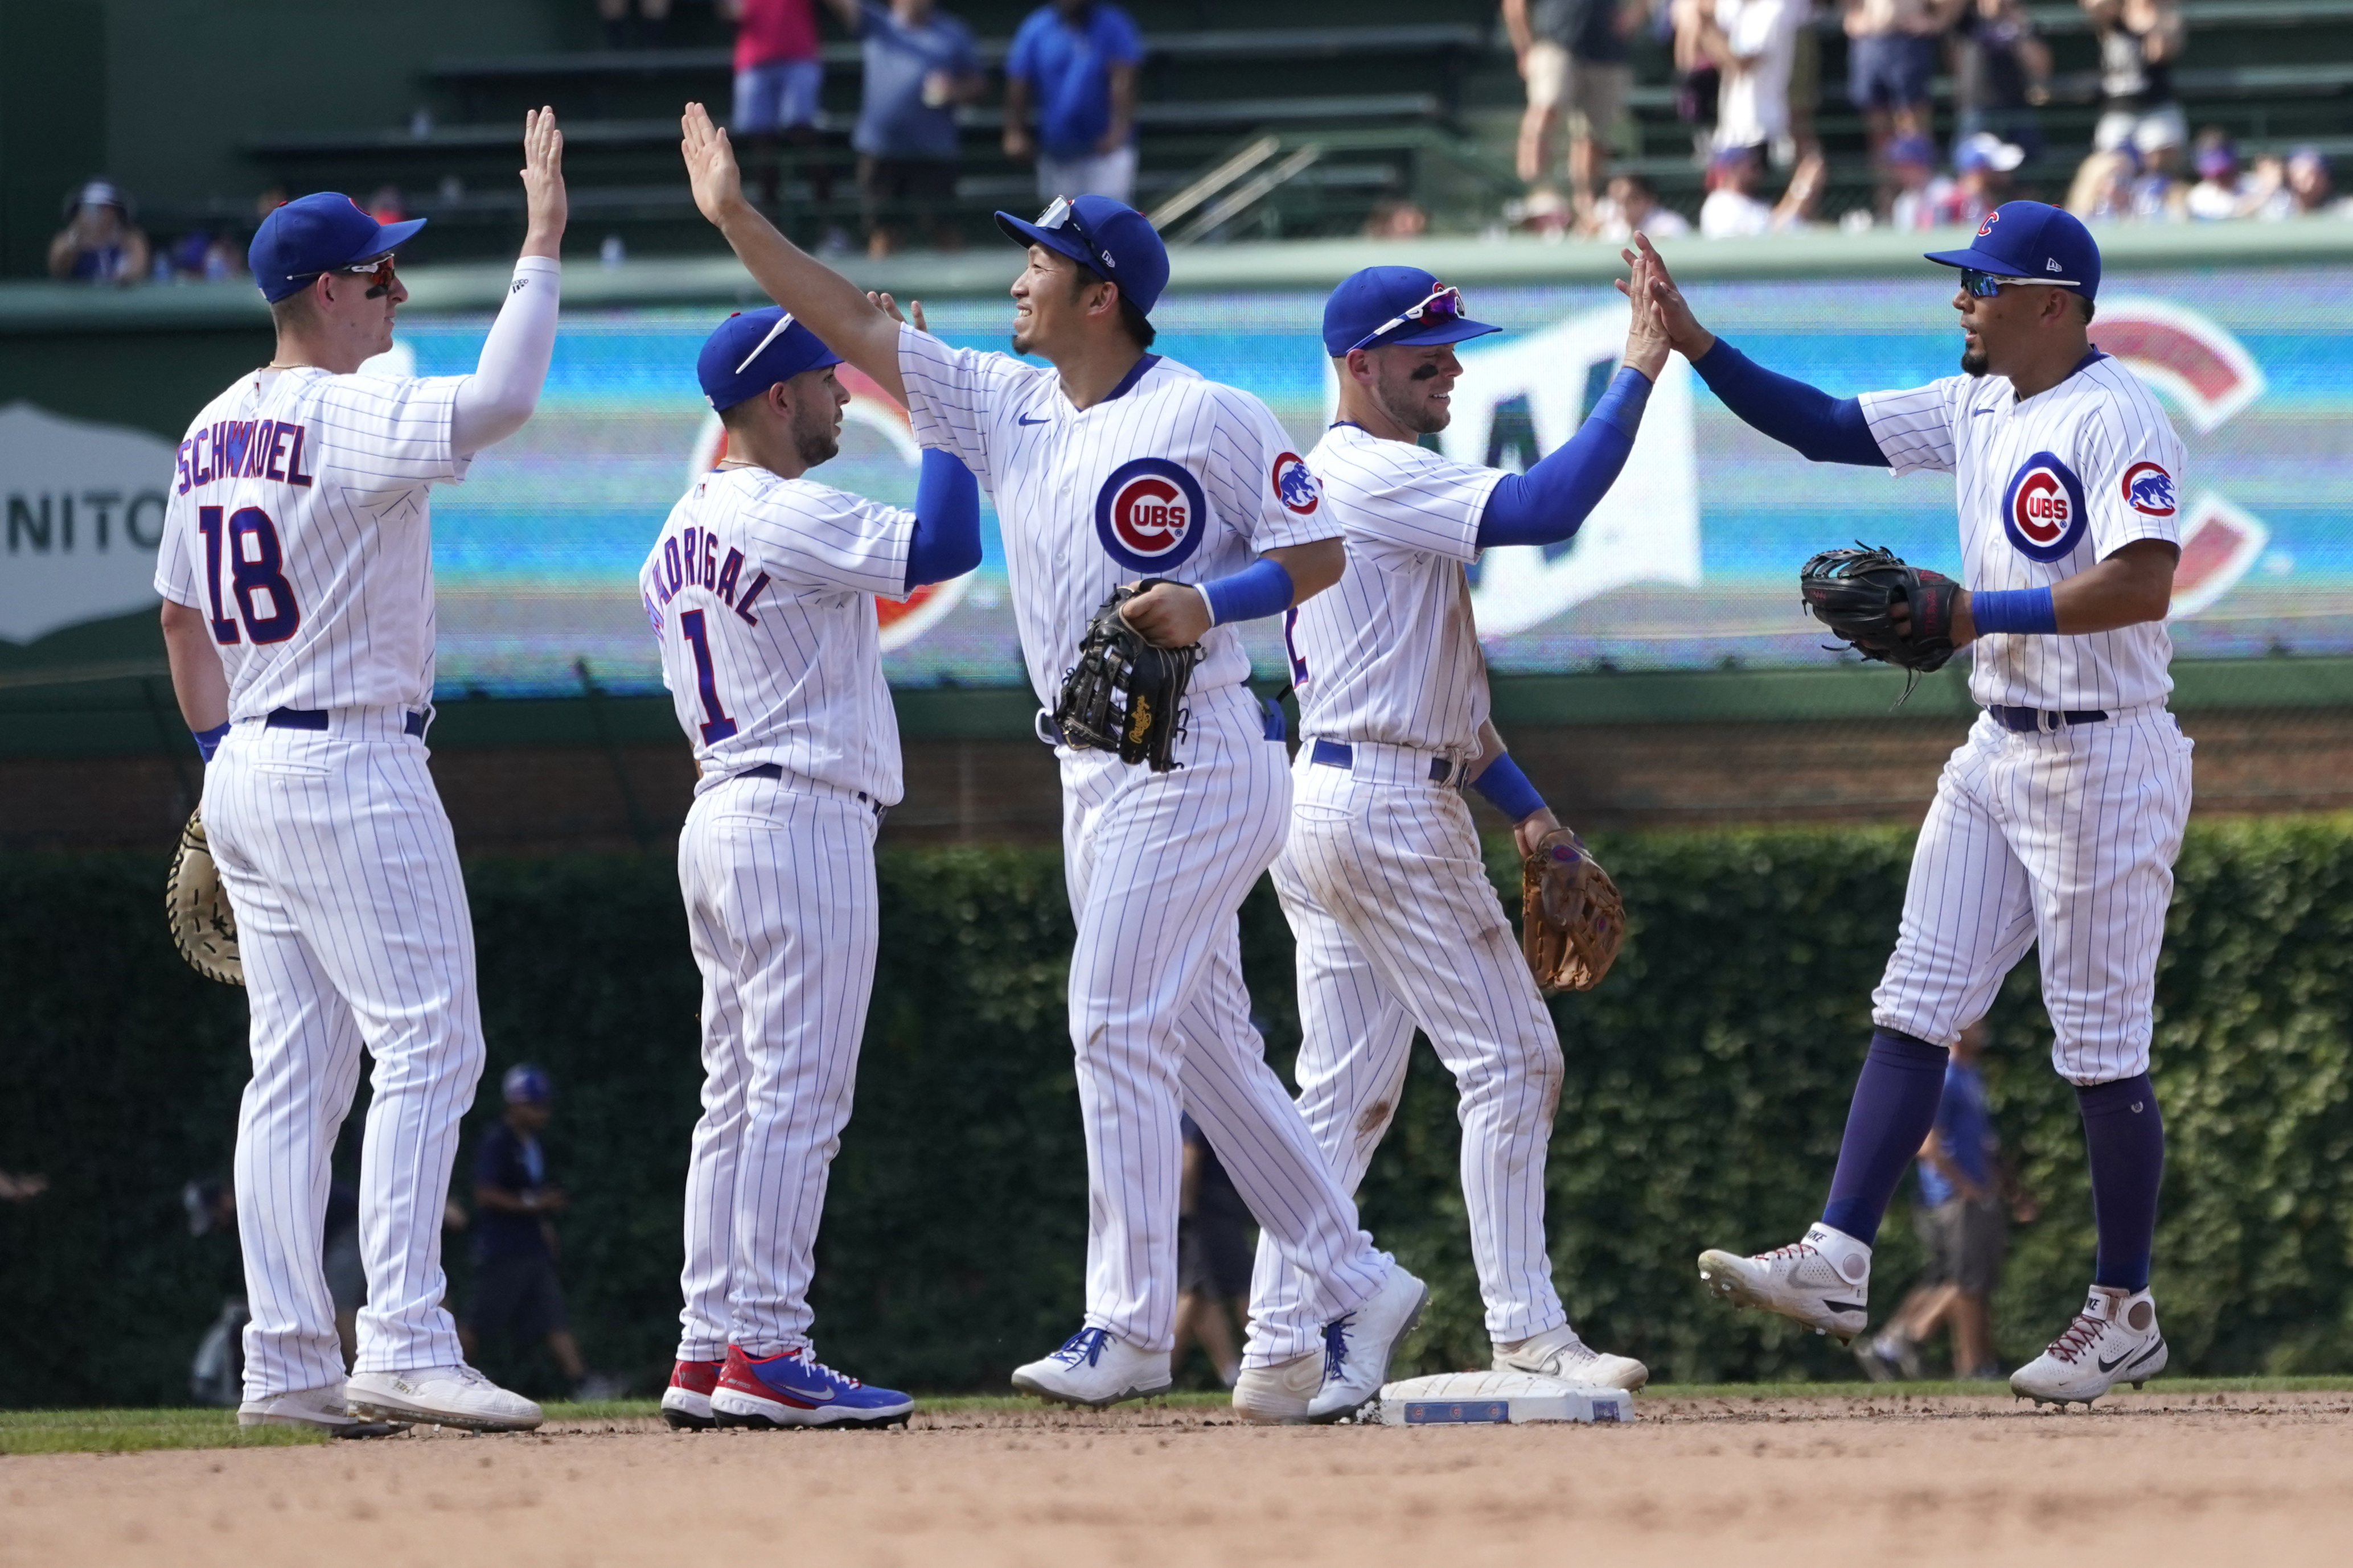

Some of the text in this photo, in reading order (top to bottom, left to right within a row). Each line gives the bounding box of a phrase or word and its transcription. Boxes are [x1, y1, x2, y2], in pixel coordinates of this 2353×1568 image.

[178, 419, 312, 496] SCHWIDEL
[1115, 479, 1186, 552] CUBS
[2016, 472, 2067, 542] CUBS
[199, 506, 300, 645] 18
[680, 608, 738, 748] 1
